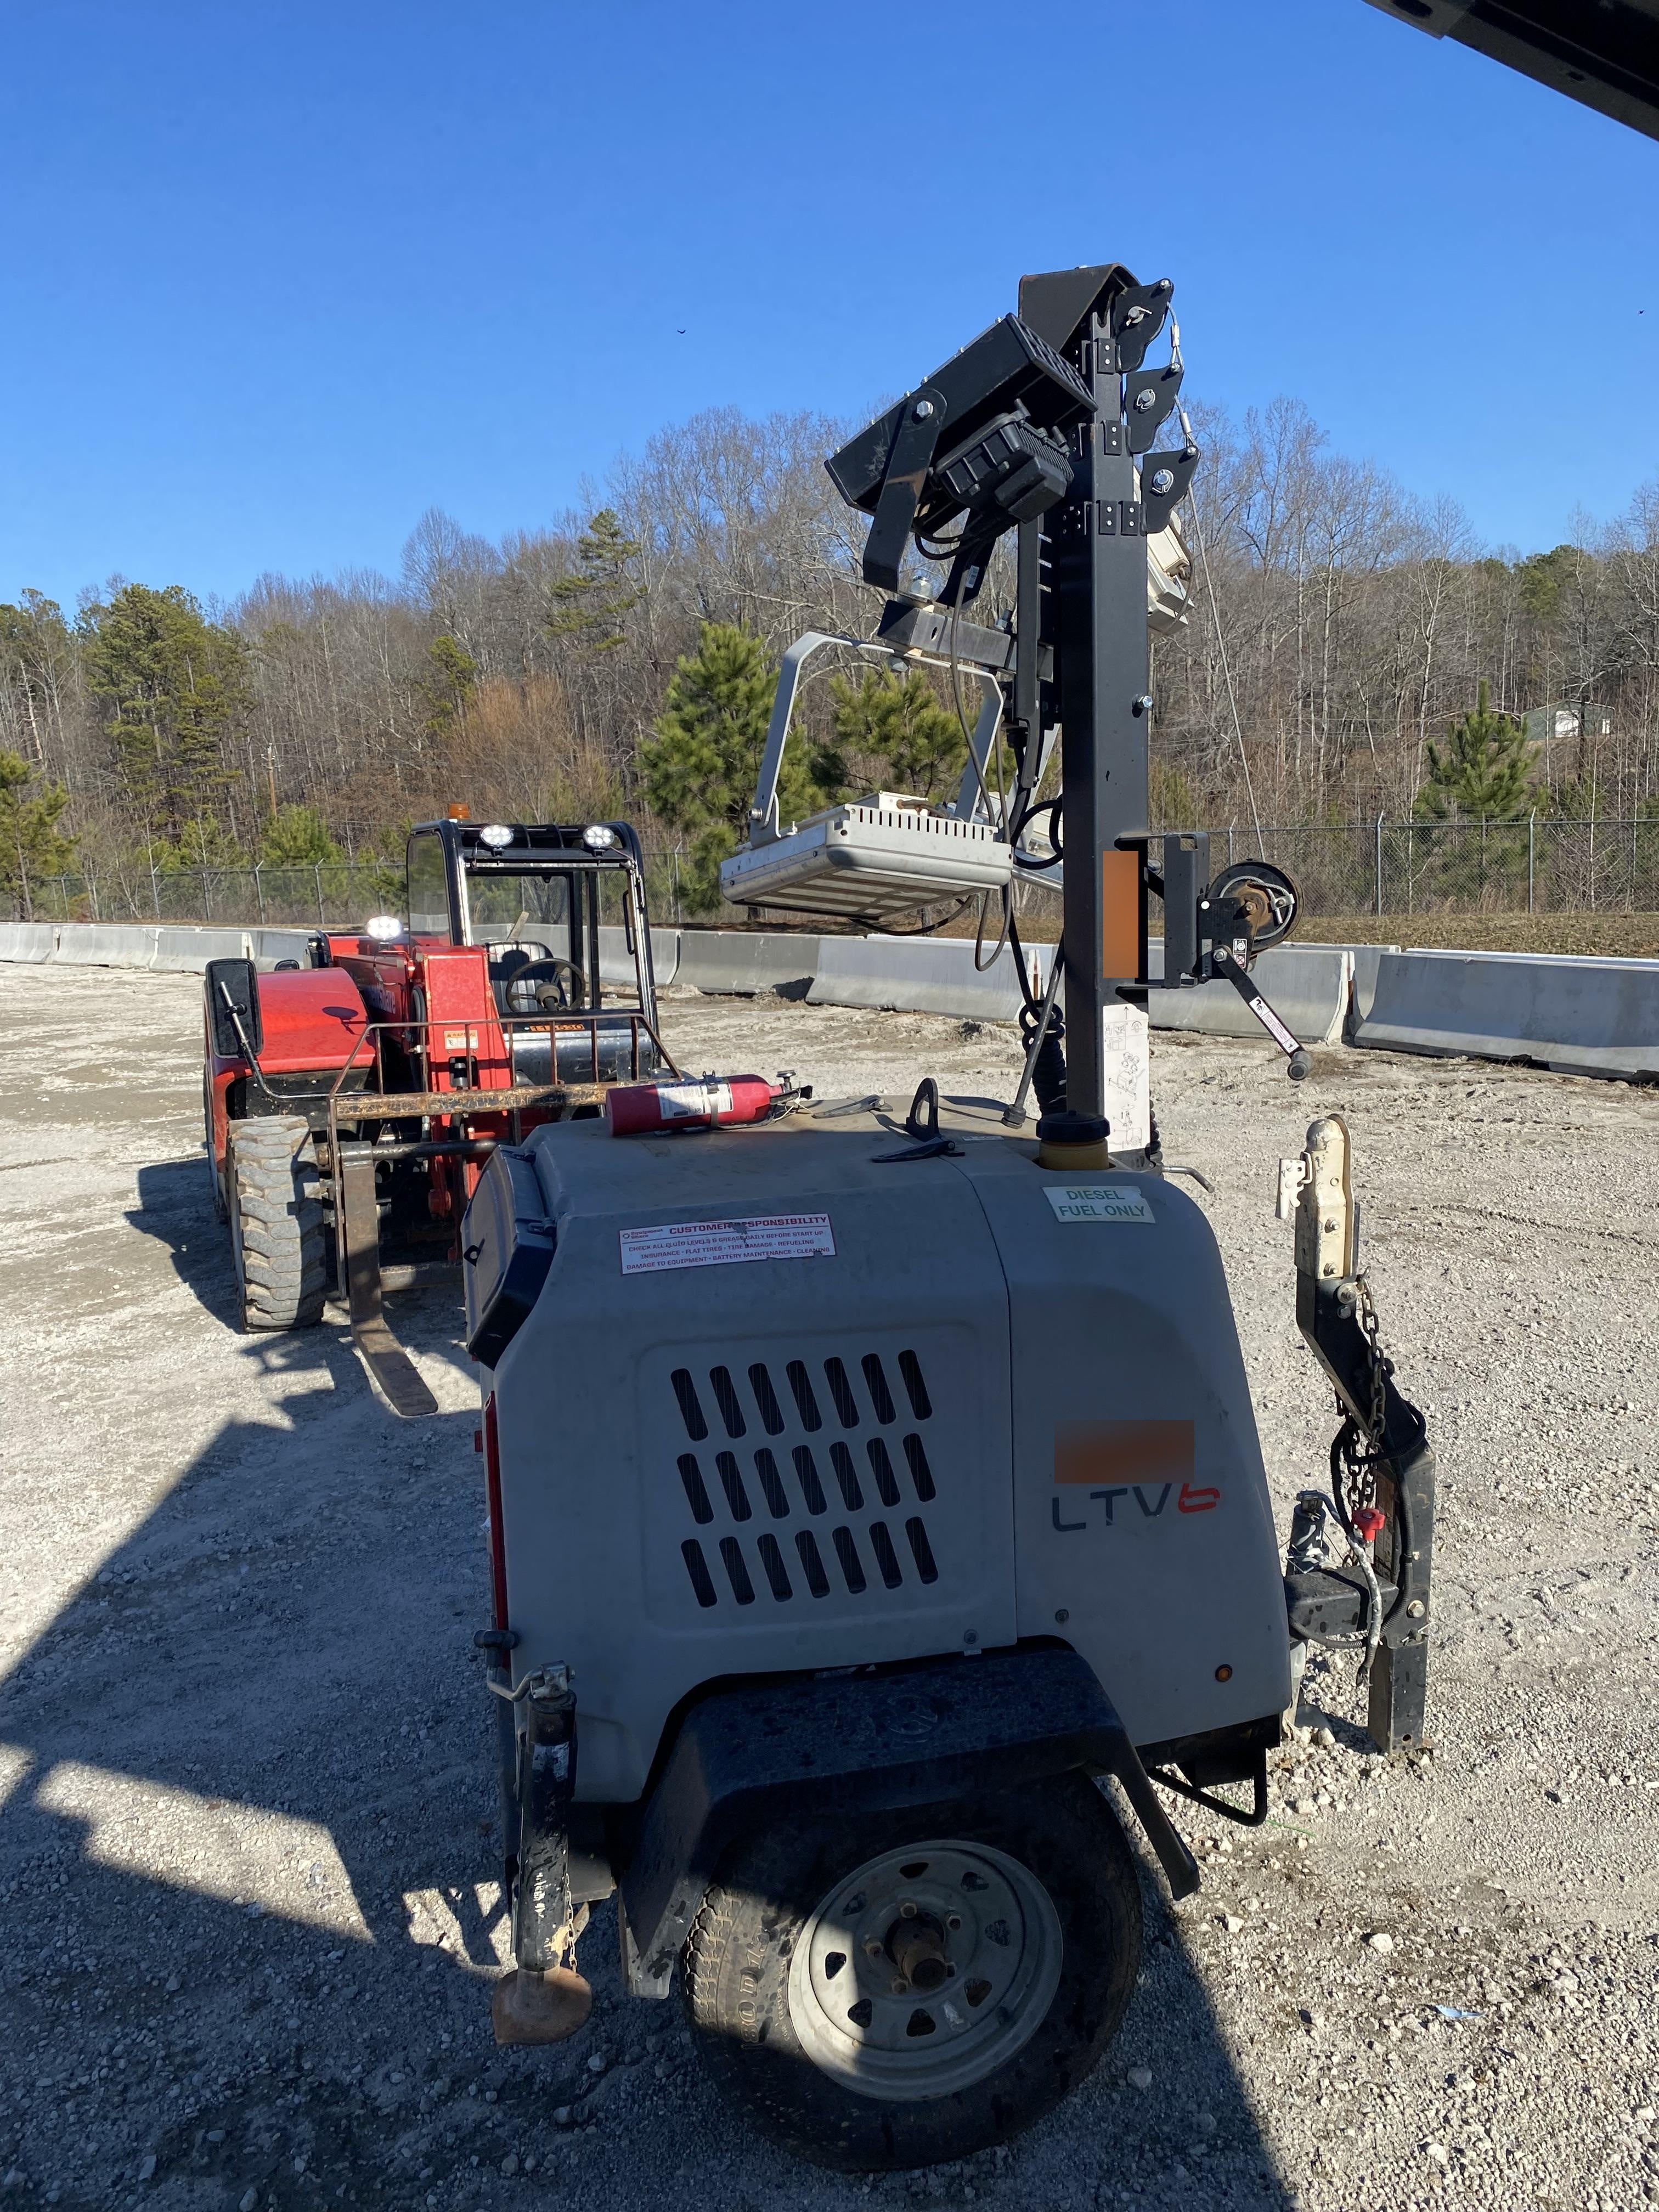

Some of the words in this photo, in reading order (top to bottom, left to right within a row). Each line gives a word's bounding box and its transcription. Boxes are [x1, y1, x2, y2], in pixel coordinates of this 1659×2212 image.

[1066, 1190, 1125, 1200] DIESEL
[1058, 1205, 1102, 1216] FUEL
[1105, 1205, 1146, 1216] ONLY
[669, 1223, 731, 1234] CUSTOMER
[641, 1251, 680, 1260] INSURANCE
[627, 1262, 655, 1270] DAMAGE
[667, 1257, 707, 1265] EQUIPMENT
